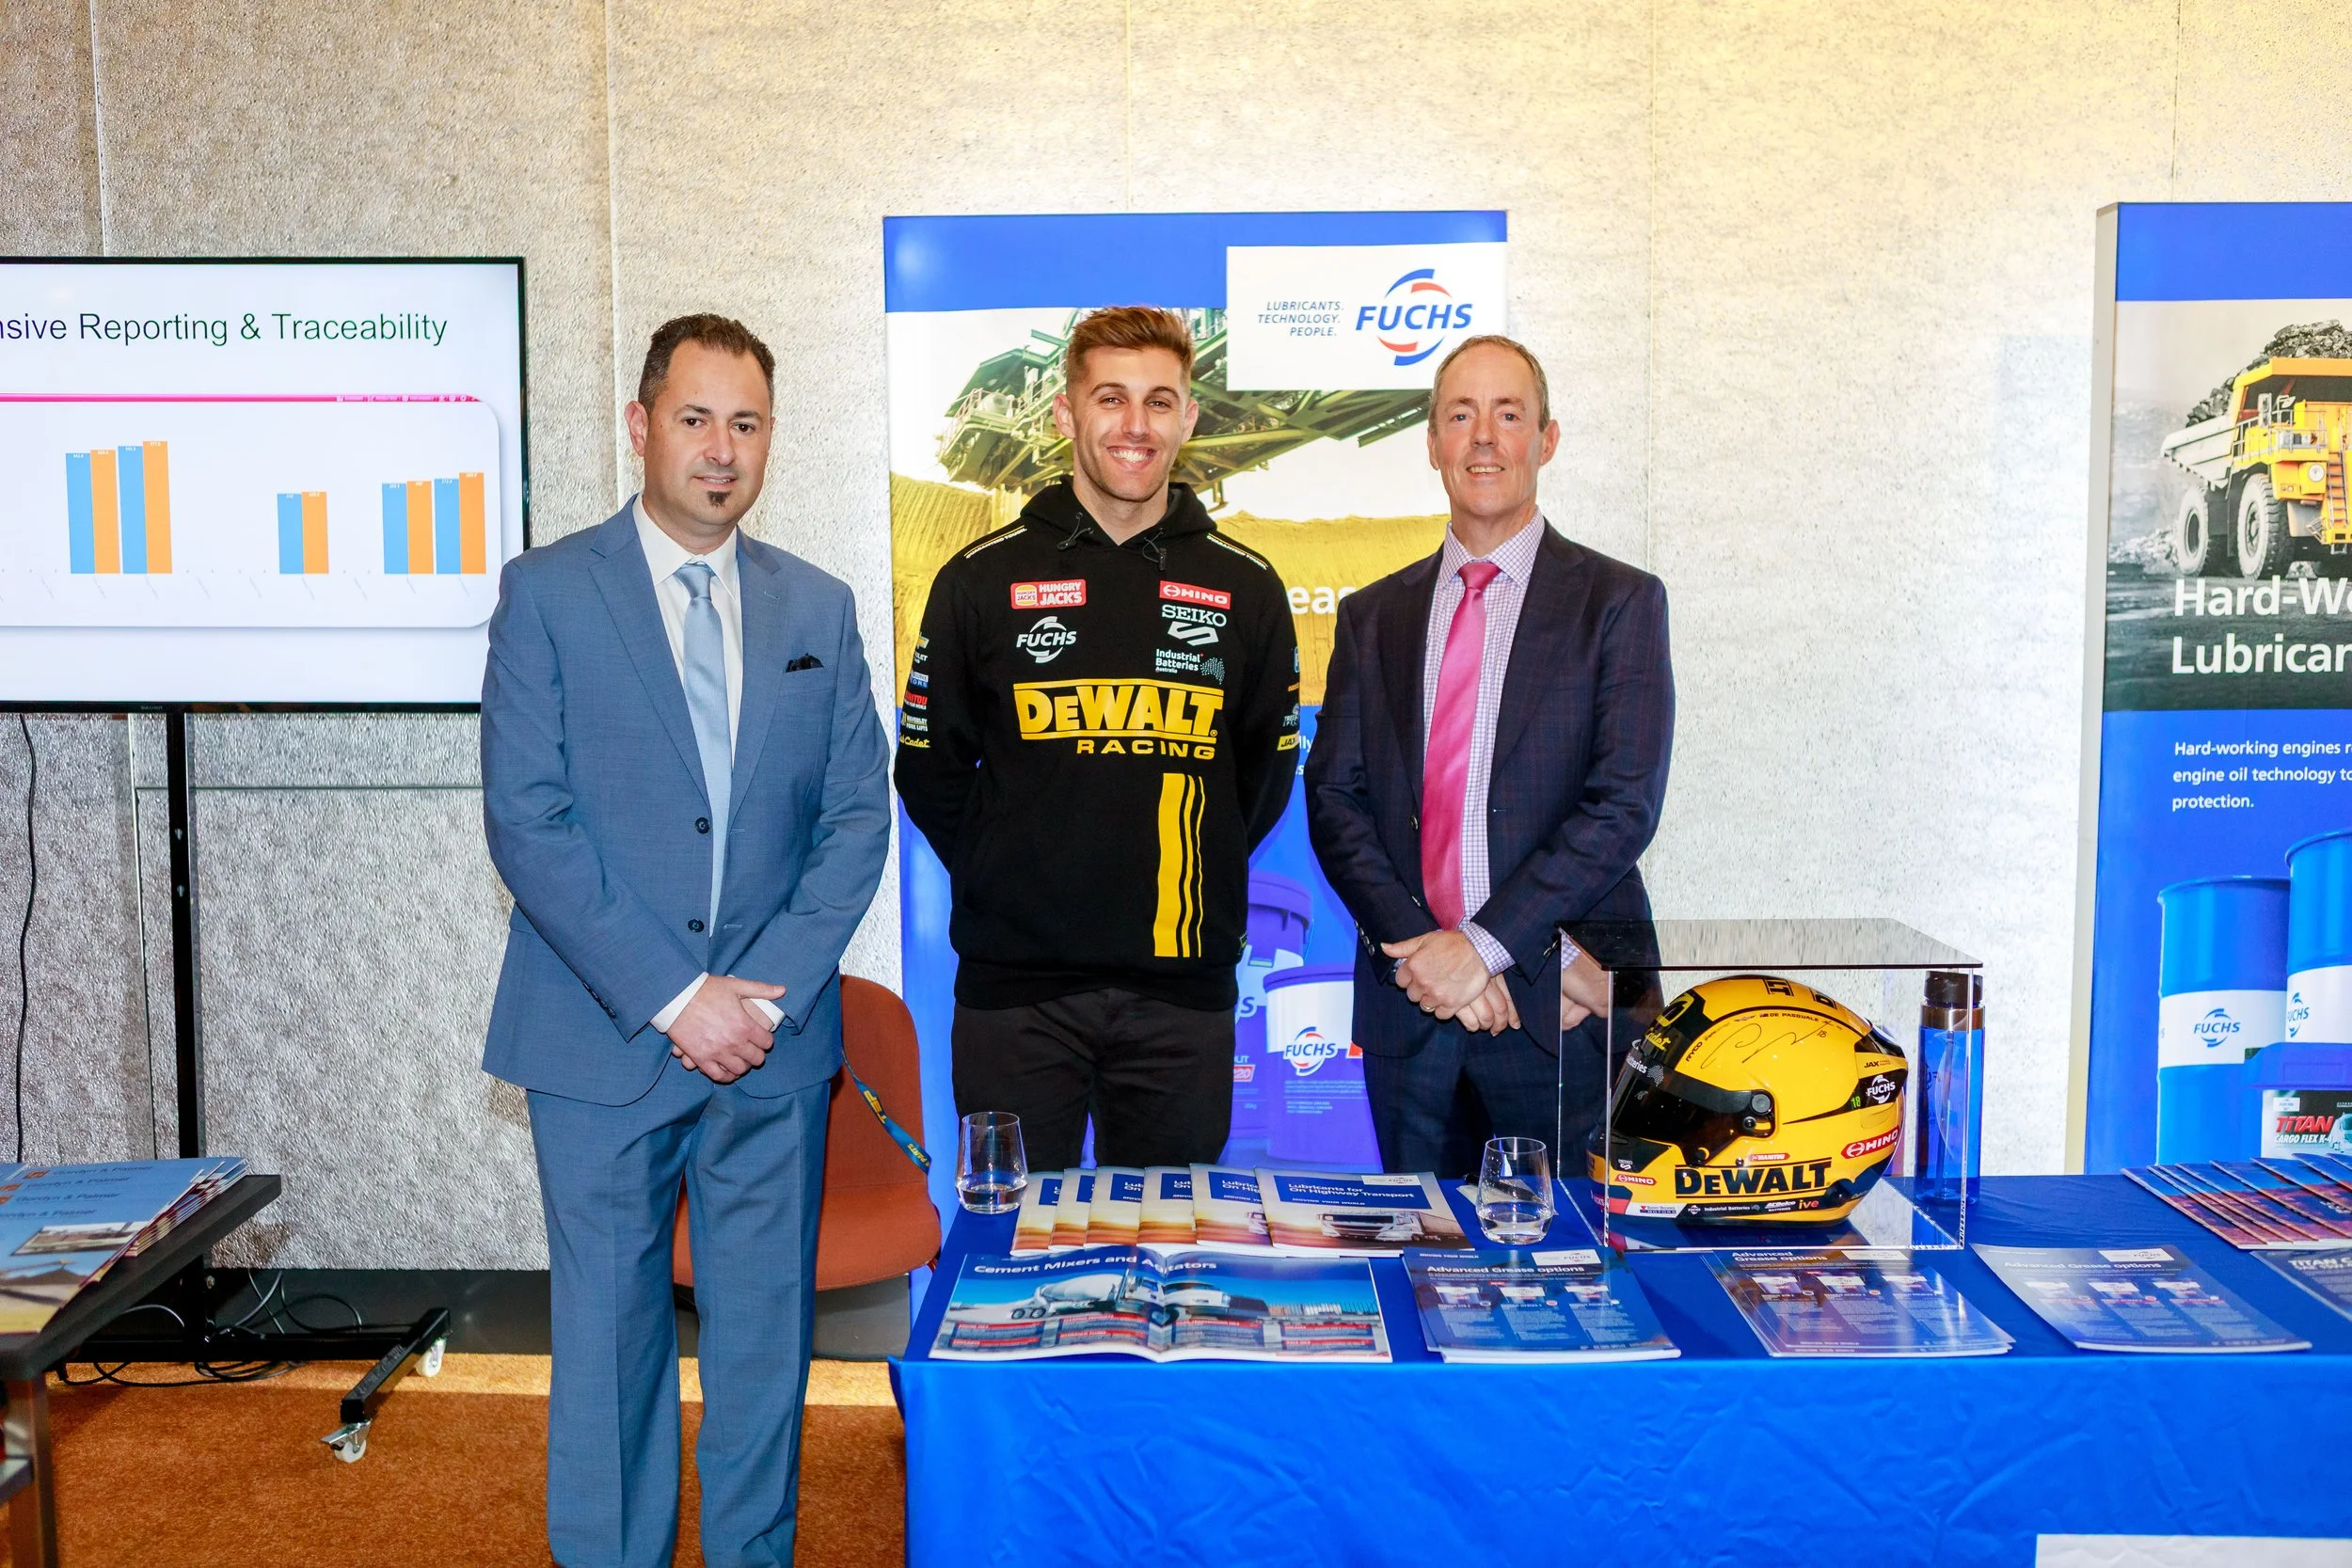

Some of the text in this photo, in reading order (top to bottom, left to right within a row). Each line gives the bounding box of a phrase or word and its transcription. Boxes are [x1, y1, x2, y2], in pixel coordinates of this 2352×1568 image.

[1266, 301, 1344, 311] LUBRICANTS.
[1258, 313, 1342, 325] TECHNOLOGY.
[1356, 304, 1472, 331] FUCHS
[79, 313, 229, 346] Reporting
[241, 314, 262, 341] &
[272, 313, 449, 346] Traceability
[1290, 326, 1337, 337] PEOPLE.
[1039, 581, 1082, 593] HUNGRY
[1181, 588, 1228, 605] HINO
[2174, 575, 2352, 616] Hard-W
[1162, 604, 1227, 627] SEIKO
[1016, 631, 1077, 647] FUCHS
[1156, 648, 1200, 663] Industrial
[1156, 657, 1200, 672] Batteries
[1077, 739, 1216, 760] RACING
[2175, 741, 2278, 758] Hard-working
[2283, 741, 2341, 758] engines
[2172, 769, 2224, 785] engine
[2229, 767, 2248, 782] oil
[2252, 767, 2336, 784] technology
[2172, 794, 2254, 812] protection.
[1781, 1013, 1820, 1022] PASQUALE
[2194, 1022, 2241, 1035] FUCHS
[1285, 1042, 1337, 1057] FUCHS
[1685, 1041, 1703, 1062] RYCO
[1867, 1081, 1896, 1097] FUCHS
[1851, 1096, 1861, 1109] 18
[1866, 1129, 1899, 1151] HINO
[2275, 1134, 2299, 1144] CARGO
[2300, 1134, 2318, 1144] FLEX
[1288, 1183, 1345, 1192] Lubricants
[1627, 1177, 1654, 1185] HINO
[1308, 1188, 1359, 1198] Highway
[1362, 1192, 1415, 1200] Transport
[1799, 1200, 1820, 1210] ive
[974, 1262, 1041, 1276] Cement
[1043, 1257, 1101, 1271] Mixers
[1105, 1255, 1137, 1264] and
[1537, 1266, 1585, 1275] options
[2114, 1261, 2162, 1270] options
